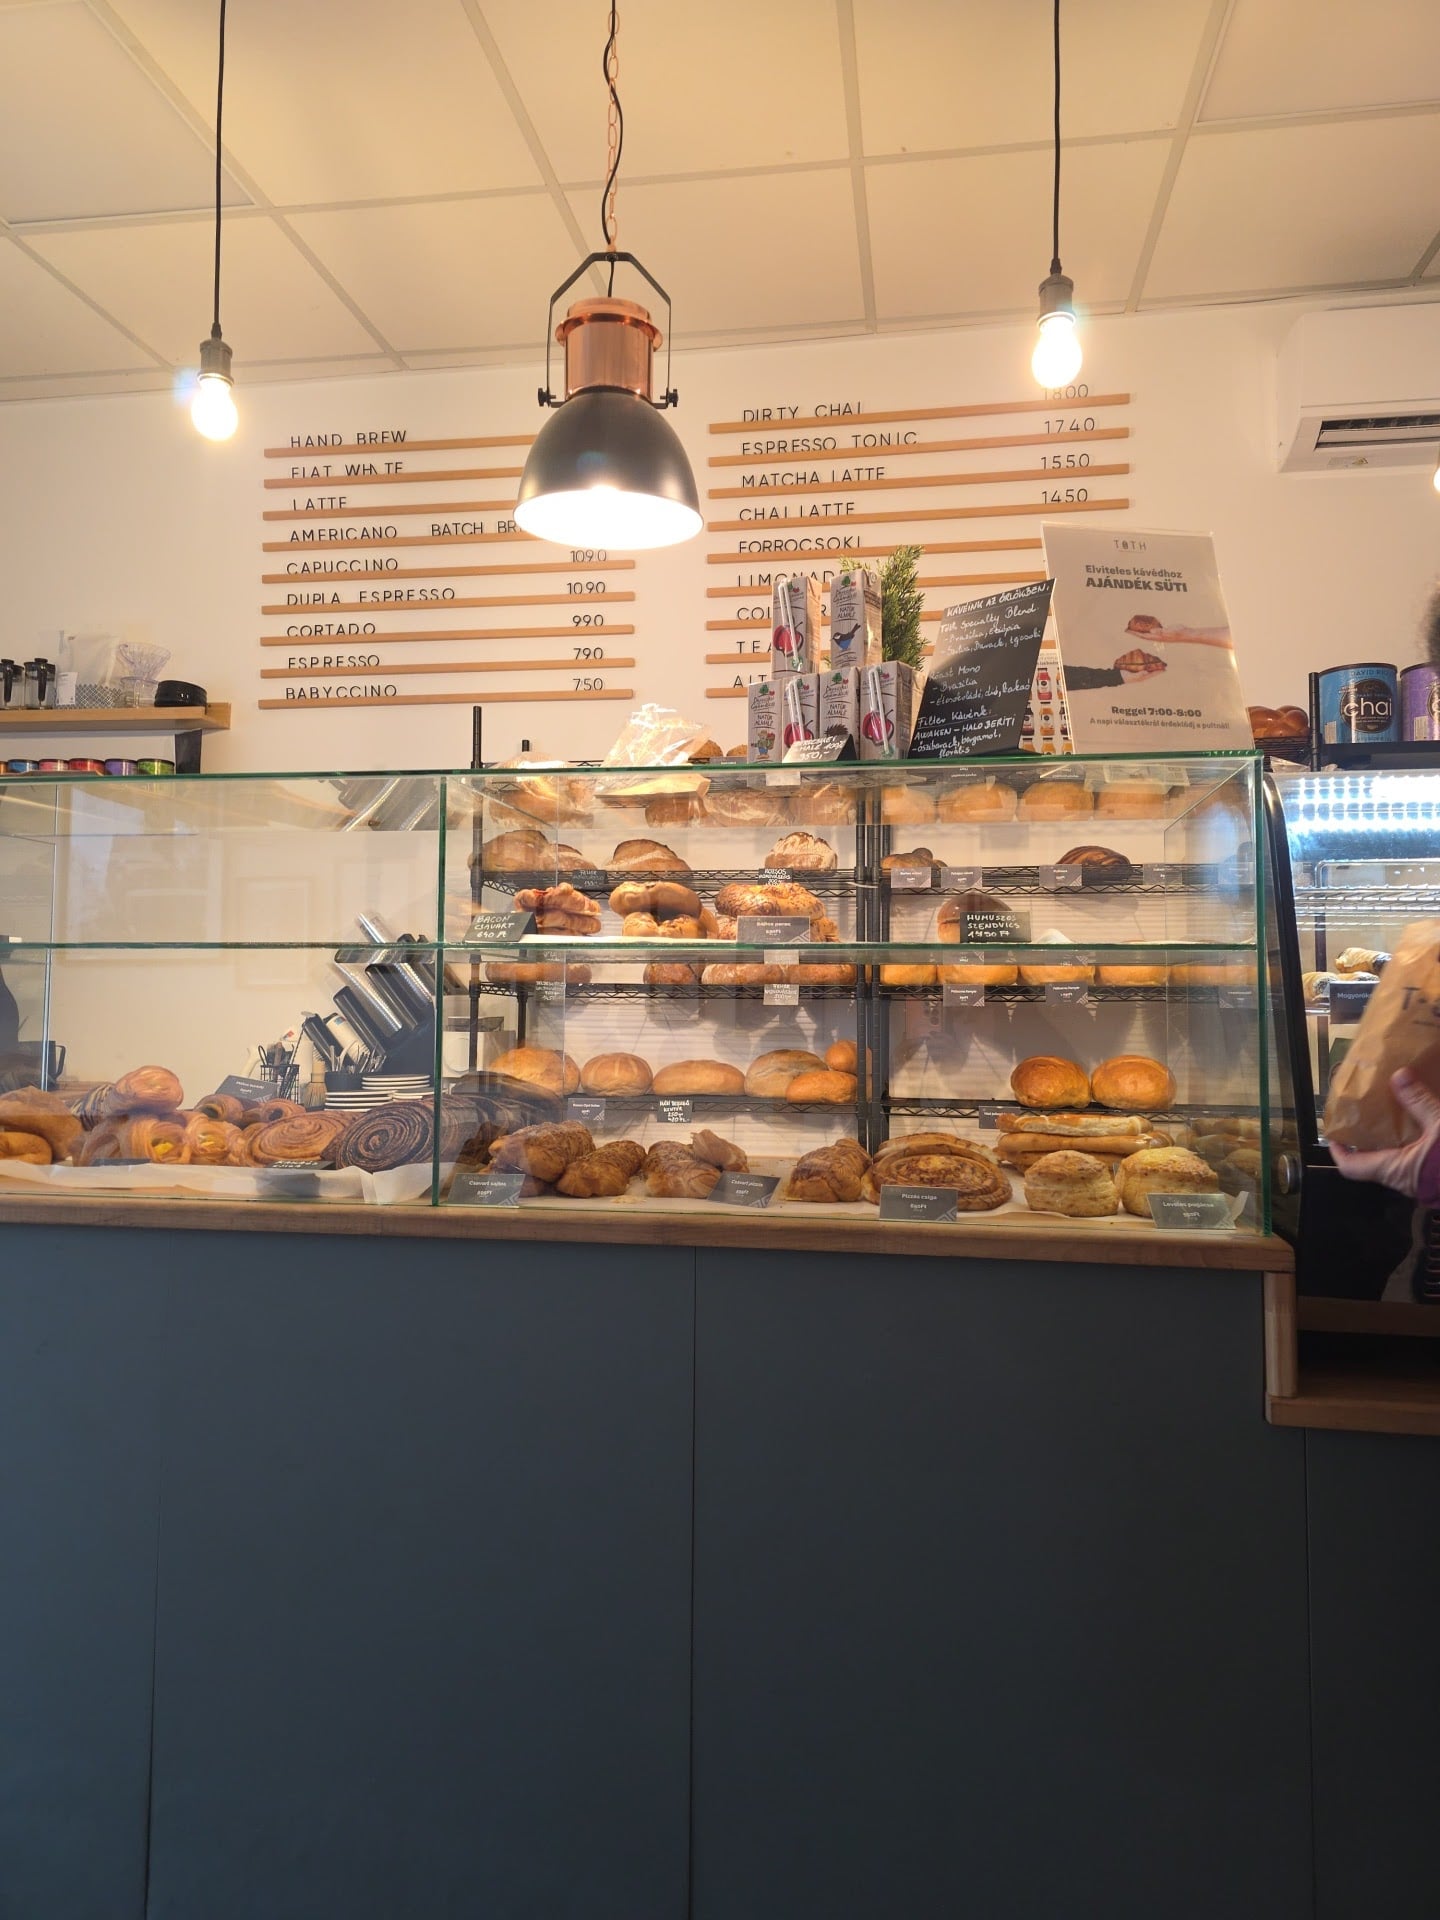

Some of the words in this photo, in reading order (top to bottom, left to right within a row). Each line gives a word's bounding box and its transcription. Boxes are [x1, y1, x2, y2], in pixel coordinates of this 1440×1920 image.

[743, 406, 799, 422] DIRTY
[814, 401, 861, 417] CHAI
[1044, 417, 1095, 434] 1740
[290, 433, 343, 448] HAND
[356, 430, 407, 445] BREW
[742, 436, 837, 455] ESPRESSO
[851, 431, 917, 449] TONIC
[1040, 453, 1090, 470] 1550
[742, 471, 820, 488] MATCHA
[1041, 488, 1088, 505] 1450
[739, 505, 788, 521] CHAI
[290, 526, 397, 542] AMERICANO
[431, 522, 483, 537] BATCH
[739, 535, 860, 554] FORROCSOKI
[286, 558, 398, 575] CAPUCCINO
[569, 549, 607, 562] 1090
[1085, 564, 1132, 576] Elviteles
[1133, 567, 1183, 579] kávédhoz
[359, 587, 455, 603] ESPRESSO
[566, 581, 606, 595] 1090
[1086, 575, 1153, 591] AJÁNDÉK
[1155, 578, 1188, 592] SÜTI
[286, 622, 376, 637] CORTADO
[572, 614, 604, 627] 990
[288, 654, 380, 669] ESPRESSO
[573, 647, 604, 660] 790
[285, 684, 397, 700] BABYCCINO
[572, 677, 603, 691] 750
[1111, 706, 1147, 717] Reggel
[1147, 707, 1202, 717] 7:00-8:00
[1343, 697, 1392, 717] chai
[477, 915, 511, 924] BACON
[967, 922, 1021, 930] SZENDVICS
